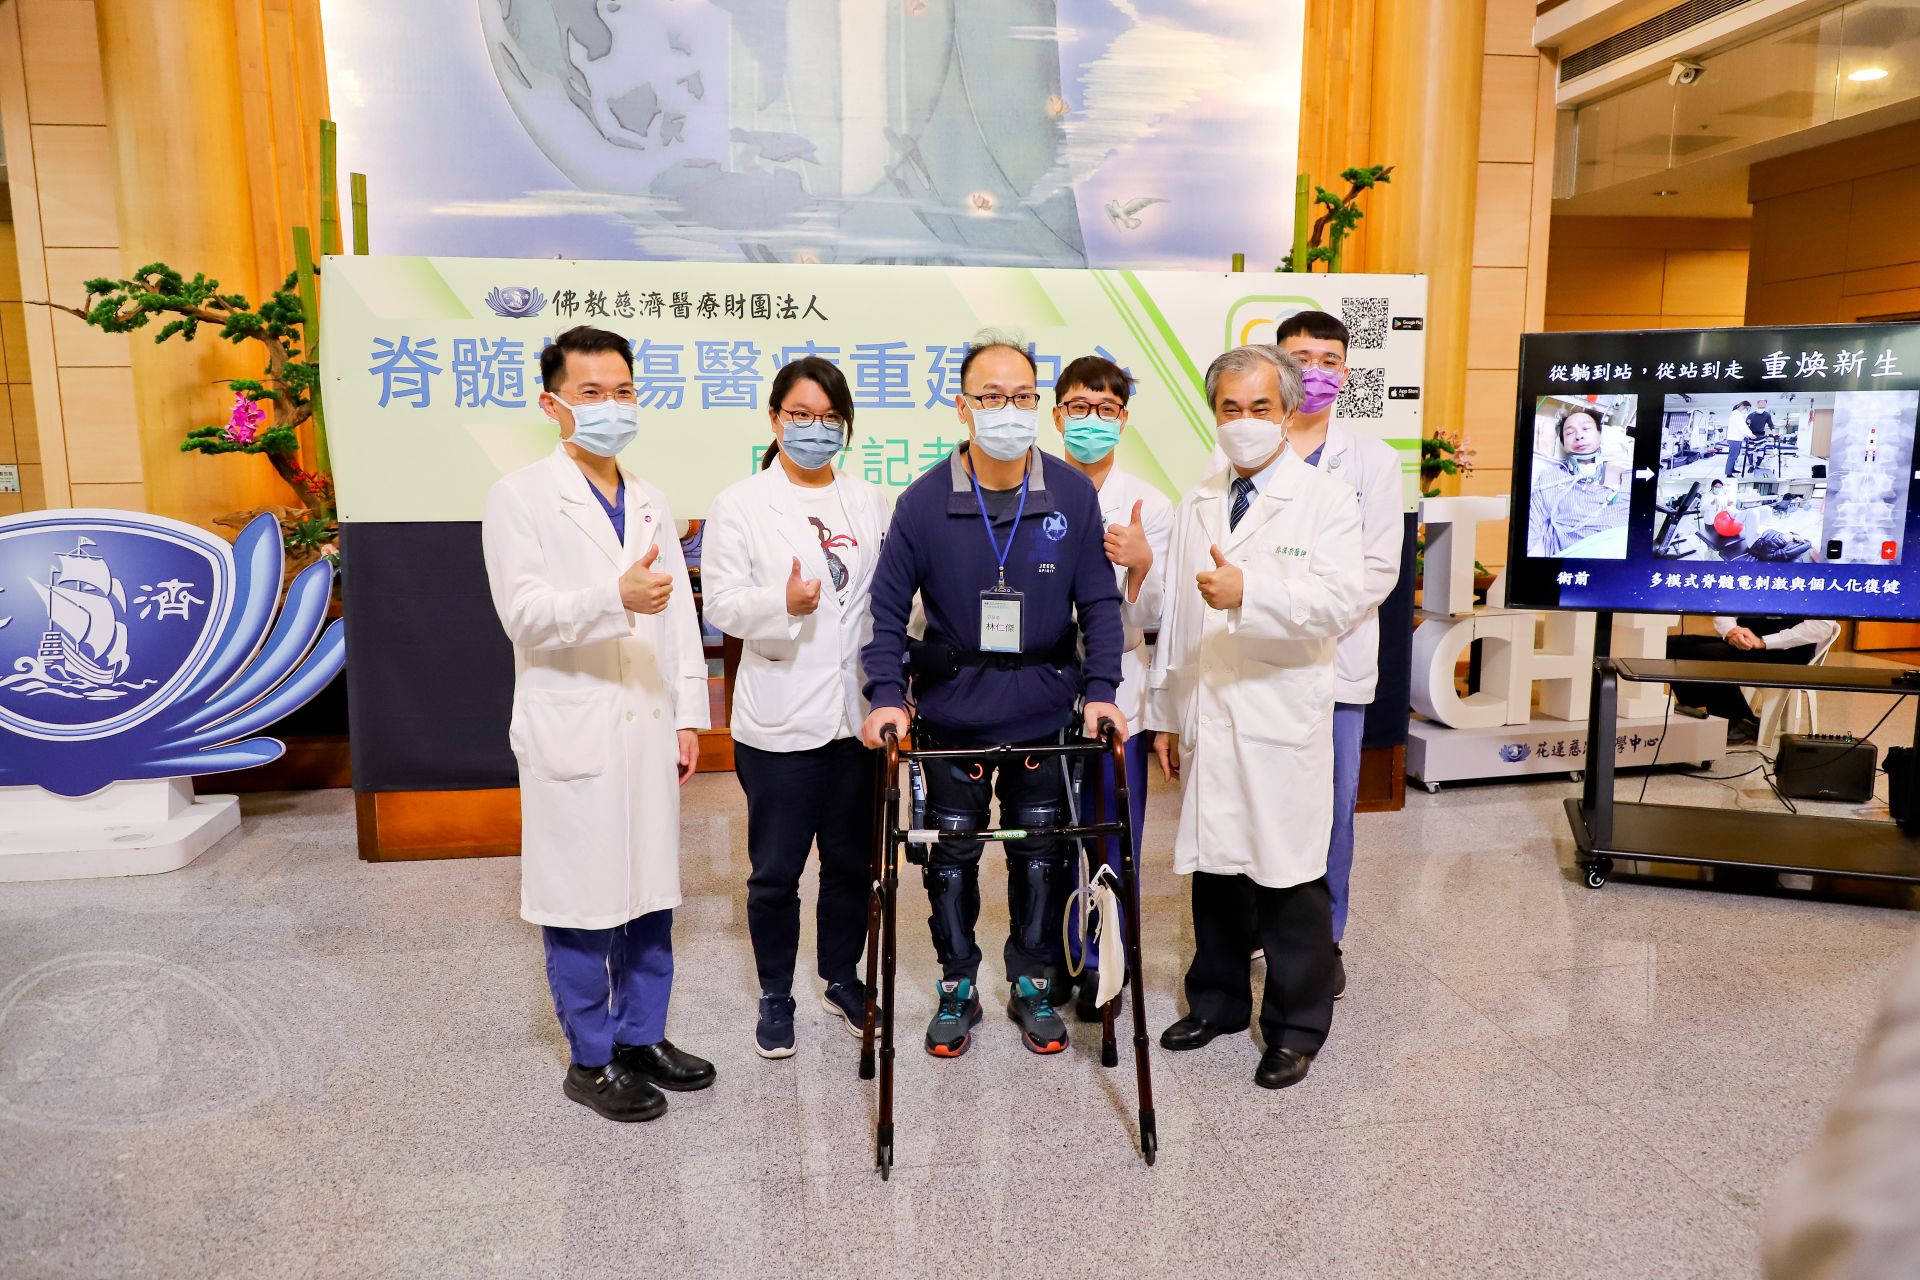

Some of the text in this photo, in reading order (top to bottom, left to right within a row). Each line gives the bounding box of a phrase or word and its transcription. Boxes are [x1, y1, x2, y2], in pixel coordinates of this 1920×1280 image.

[551, 288, 829, 321] 佛教慈濟醫療財團法人
[1549, 349, 1903, 382] 從躺到站，從站到走 重煥新生
[1556, 571, 1590, 586] 術前
[1649, 572, 1901, 594] 多模式脊髓電刺激與個人化復健
[1536, 733, 1659, 758] 花蓮慈學中心
